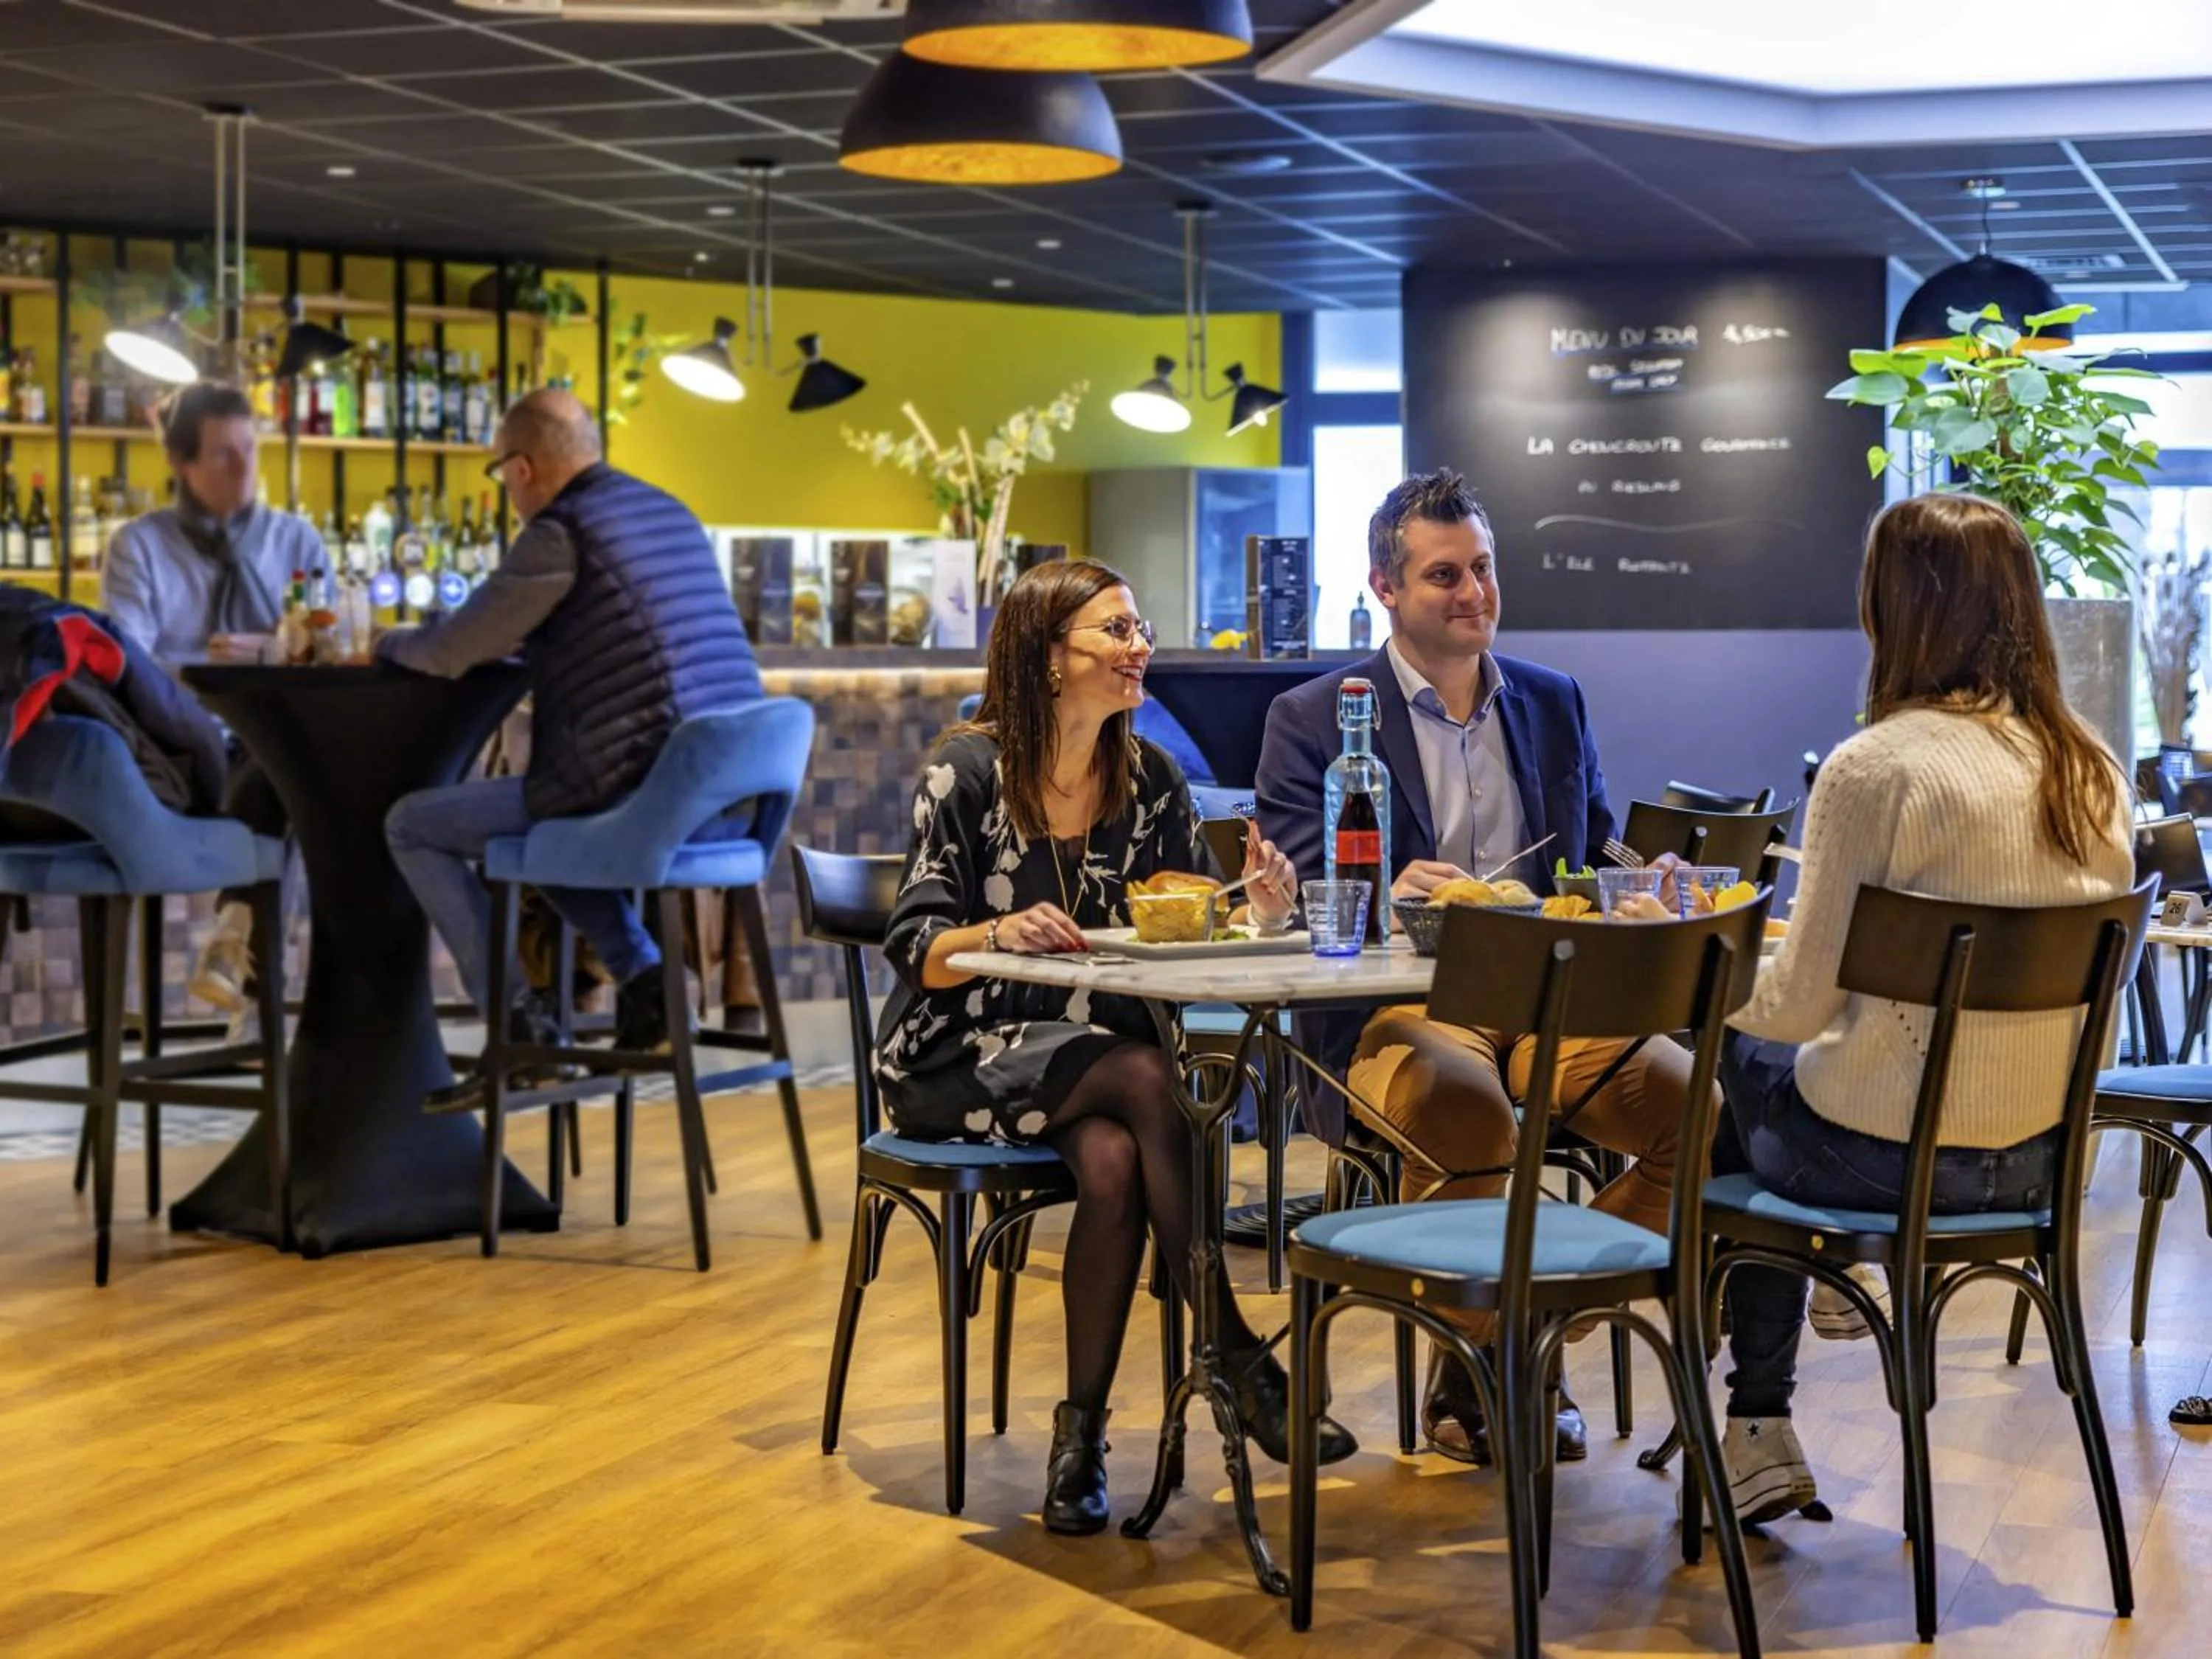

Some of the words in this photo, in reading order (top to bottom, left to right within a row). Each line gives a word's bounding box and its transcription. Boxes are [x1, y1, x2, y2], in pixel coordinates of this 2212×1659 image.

[1551, 327, 1609, 352] MENU
[1619, 326, 1646, 349] DU
[1652, 324, 1699, 345] JOUR
[1526, 436, 1554, 455] LA
[2168, 902, 2182, 914] 26
